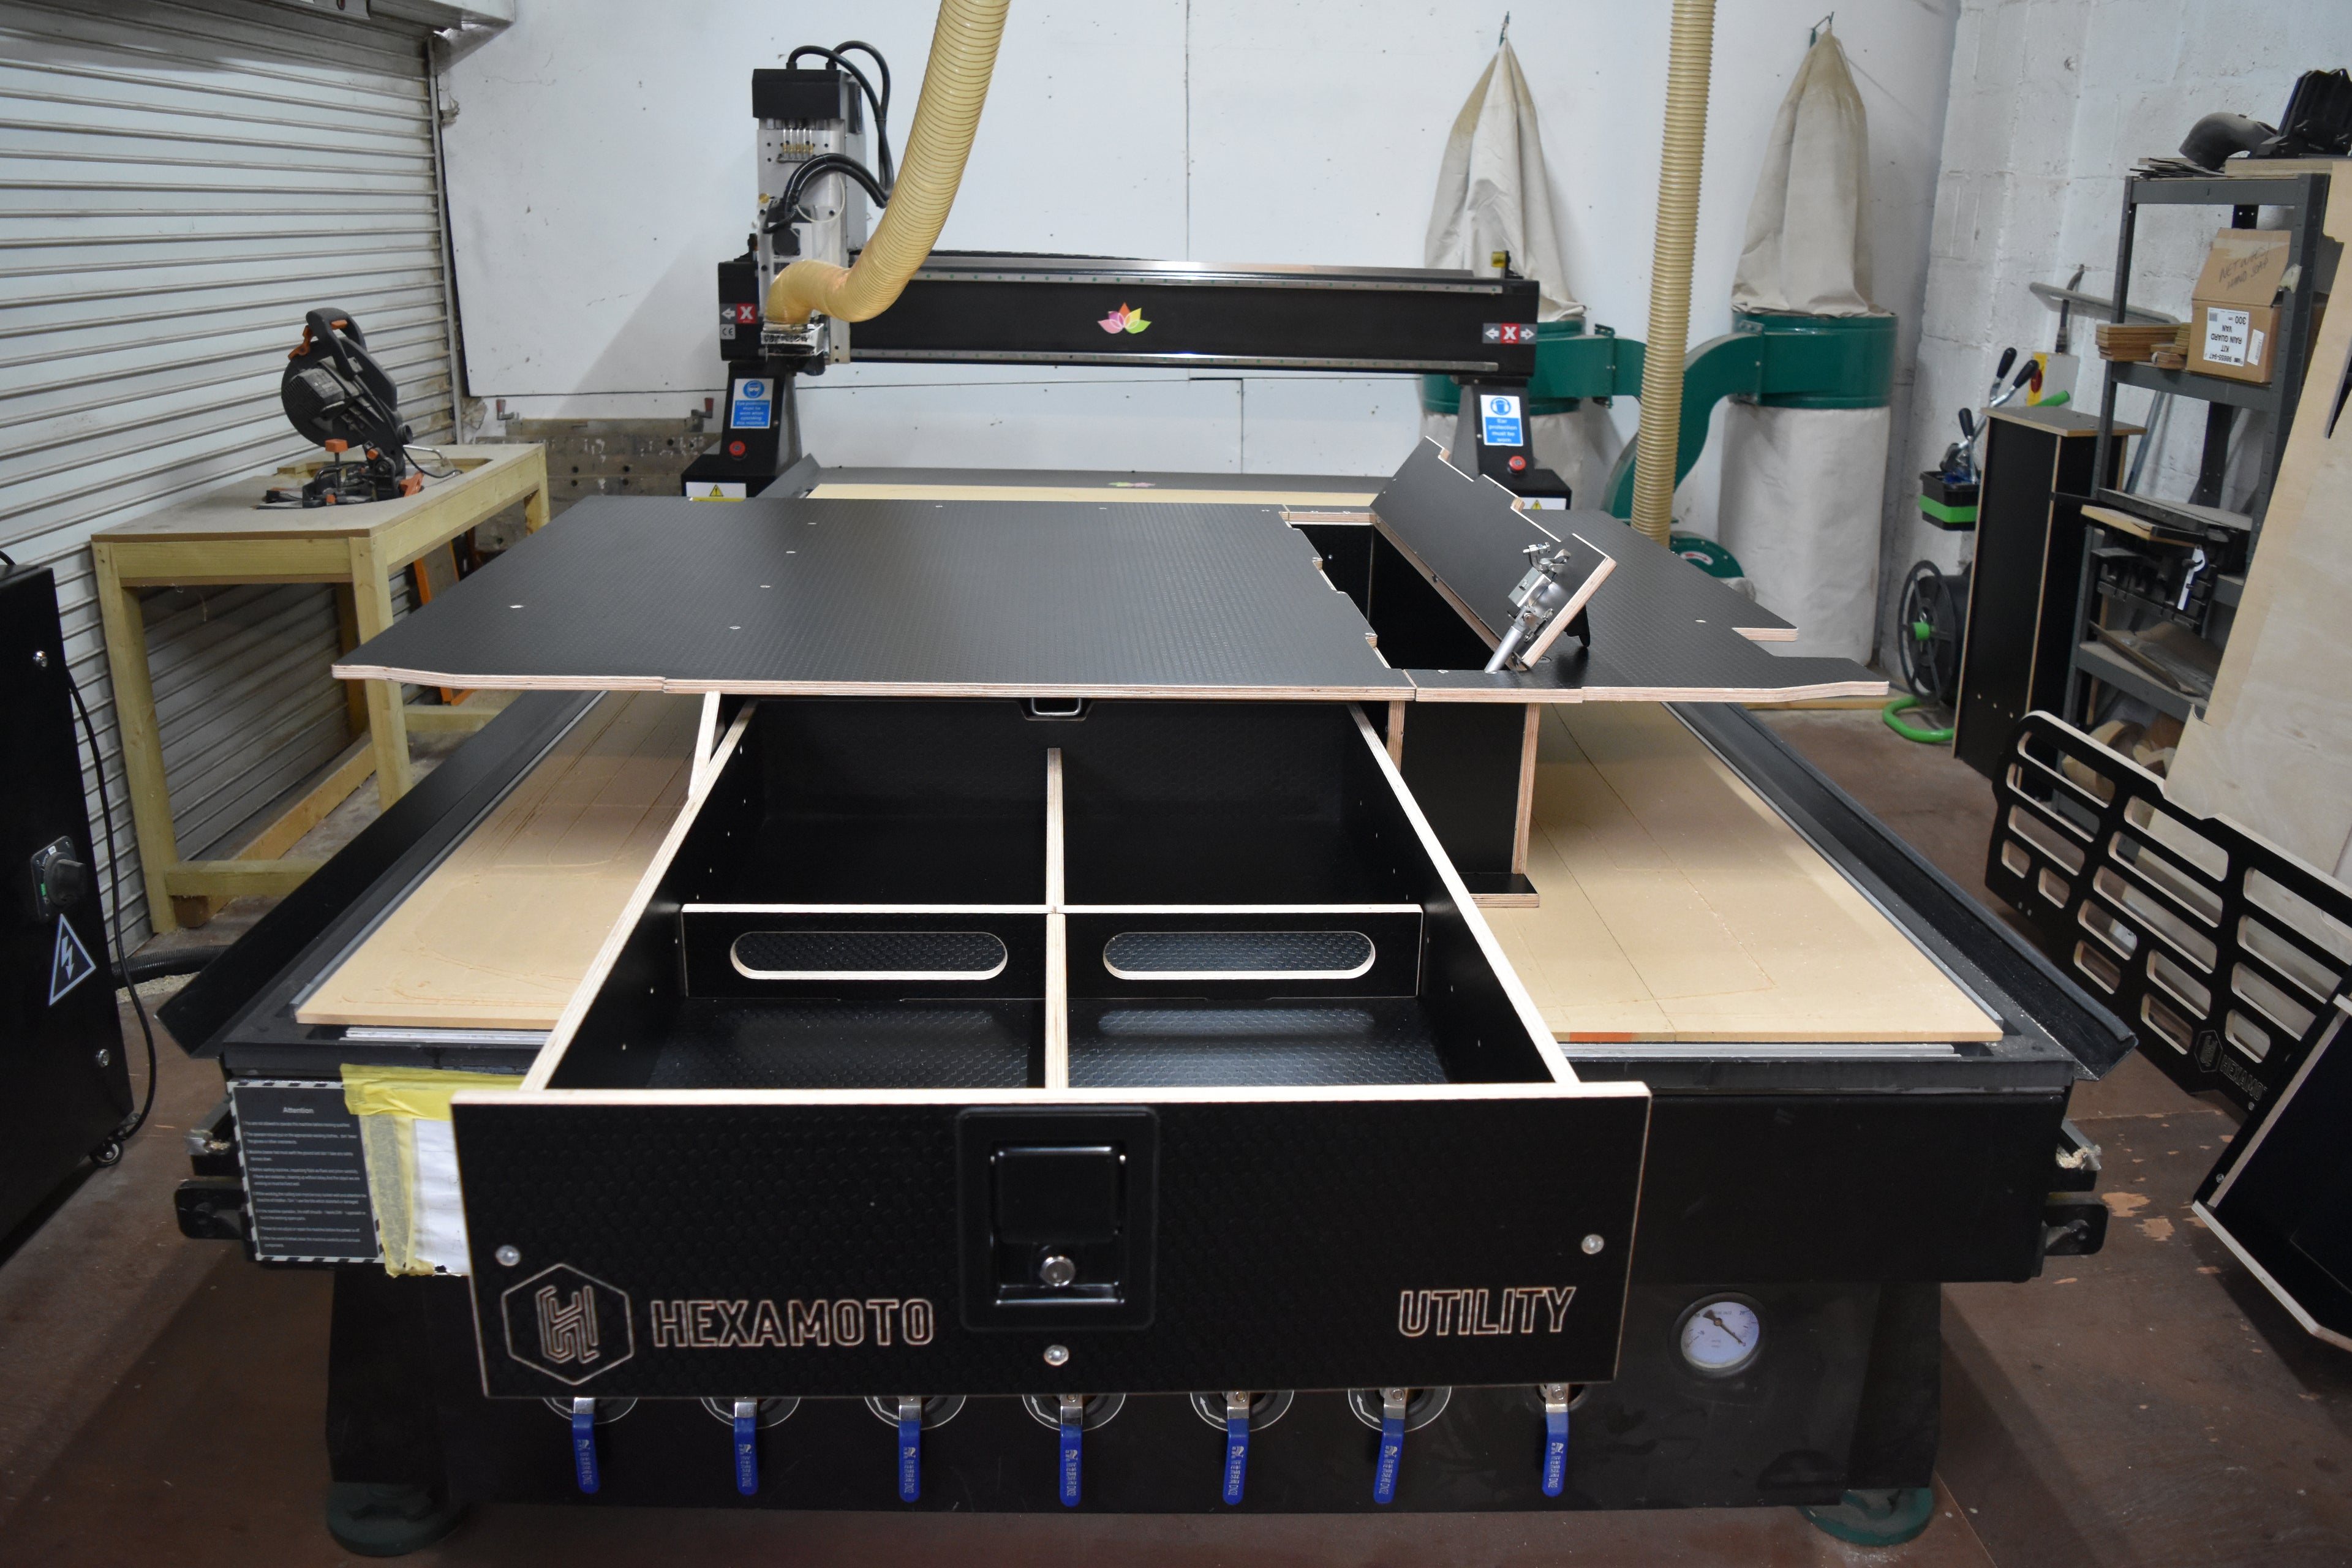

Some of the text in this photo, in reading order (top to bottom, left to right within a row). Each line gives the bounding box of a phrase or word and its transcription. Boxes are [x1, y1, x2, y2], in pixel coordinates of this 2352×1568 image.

[740, 306, 753, 320] X
[2234, 316, 2247, 325] 300
[1504, 326, 1517, 340] X
[2211, 333, 2229, 342] GUARD
[2220, 1054, 2268, 1101] HEXAMO
[1398, 1286, 1577, 1338] UTILITY
[650, 1297, 935, 1348] HEXAMOTO
